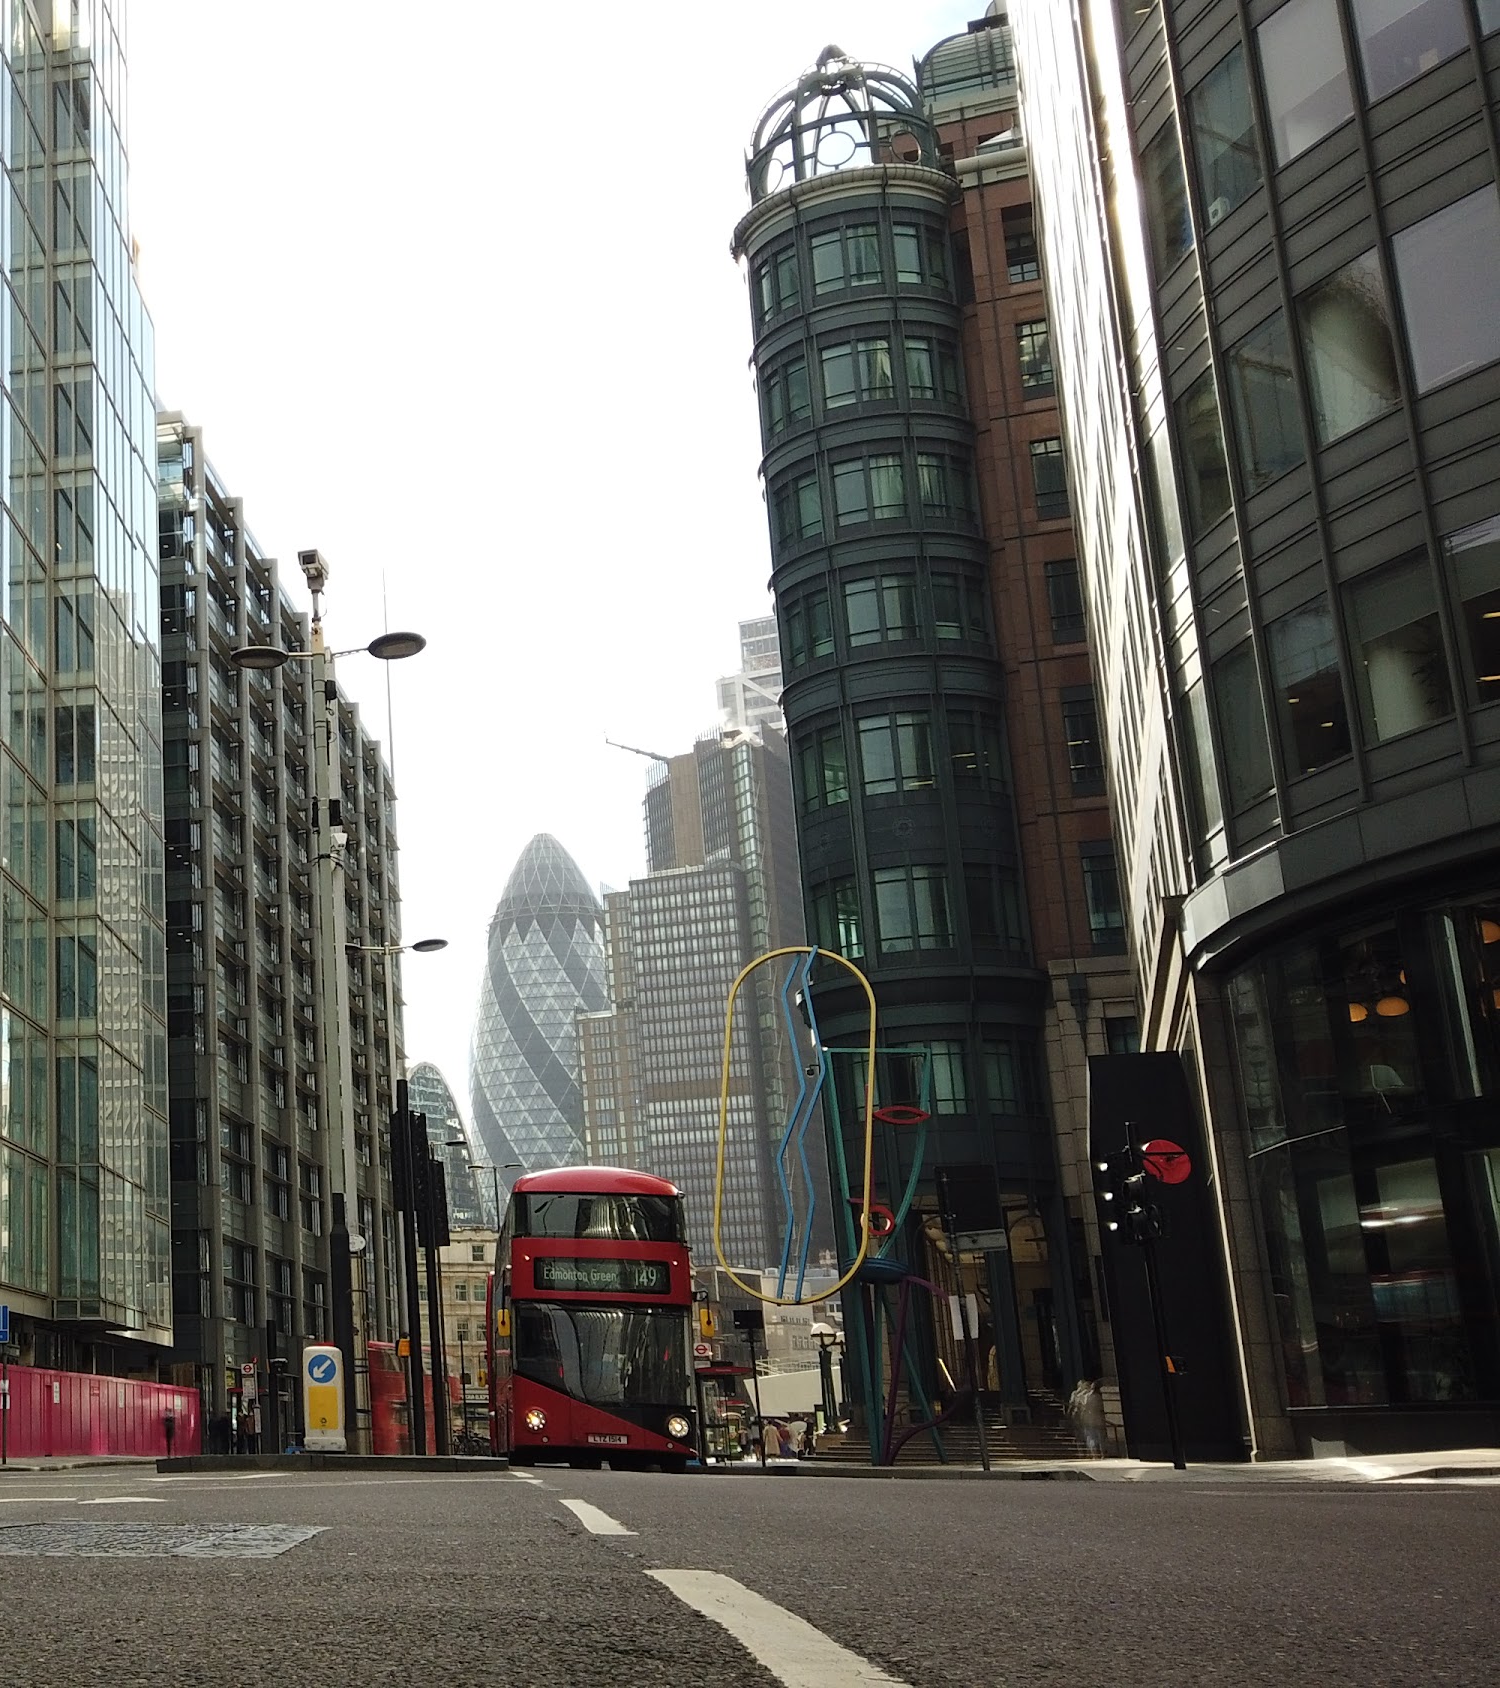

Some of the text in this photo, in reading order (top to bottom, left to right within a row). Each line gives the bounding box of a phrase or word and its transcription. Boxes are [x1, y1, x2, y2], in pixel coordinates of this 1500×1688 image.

[543, 1266, 657, 1287] Edmonton Green 149
